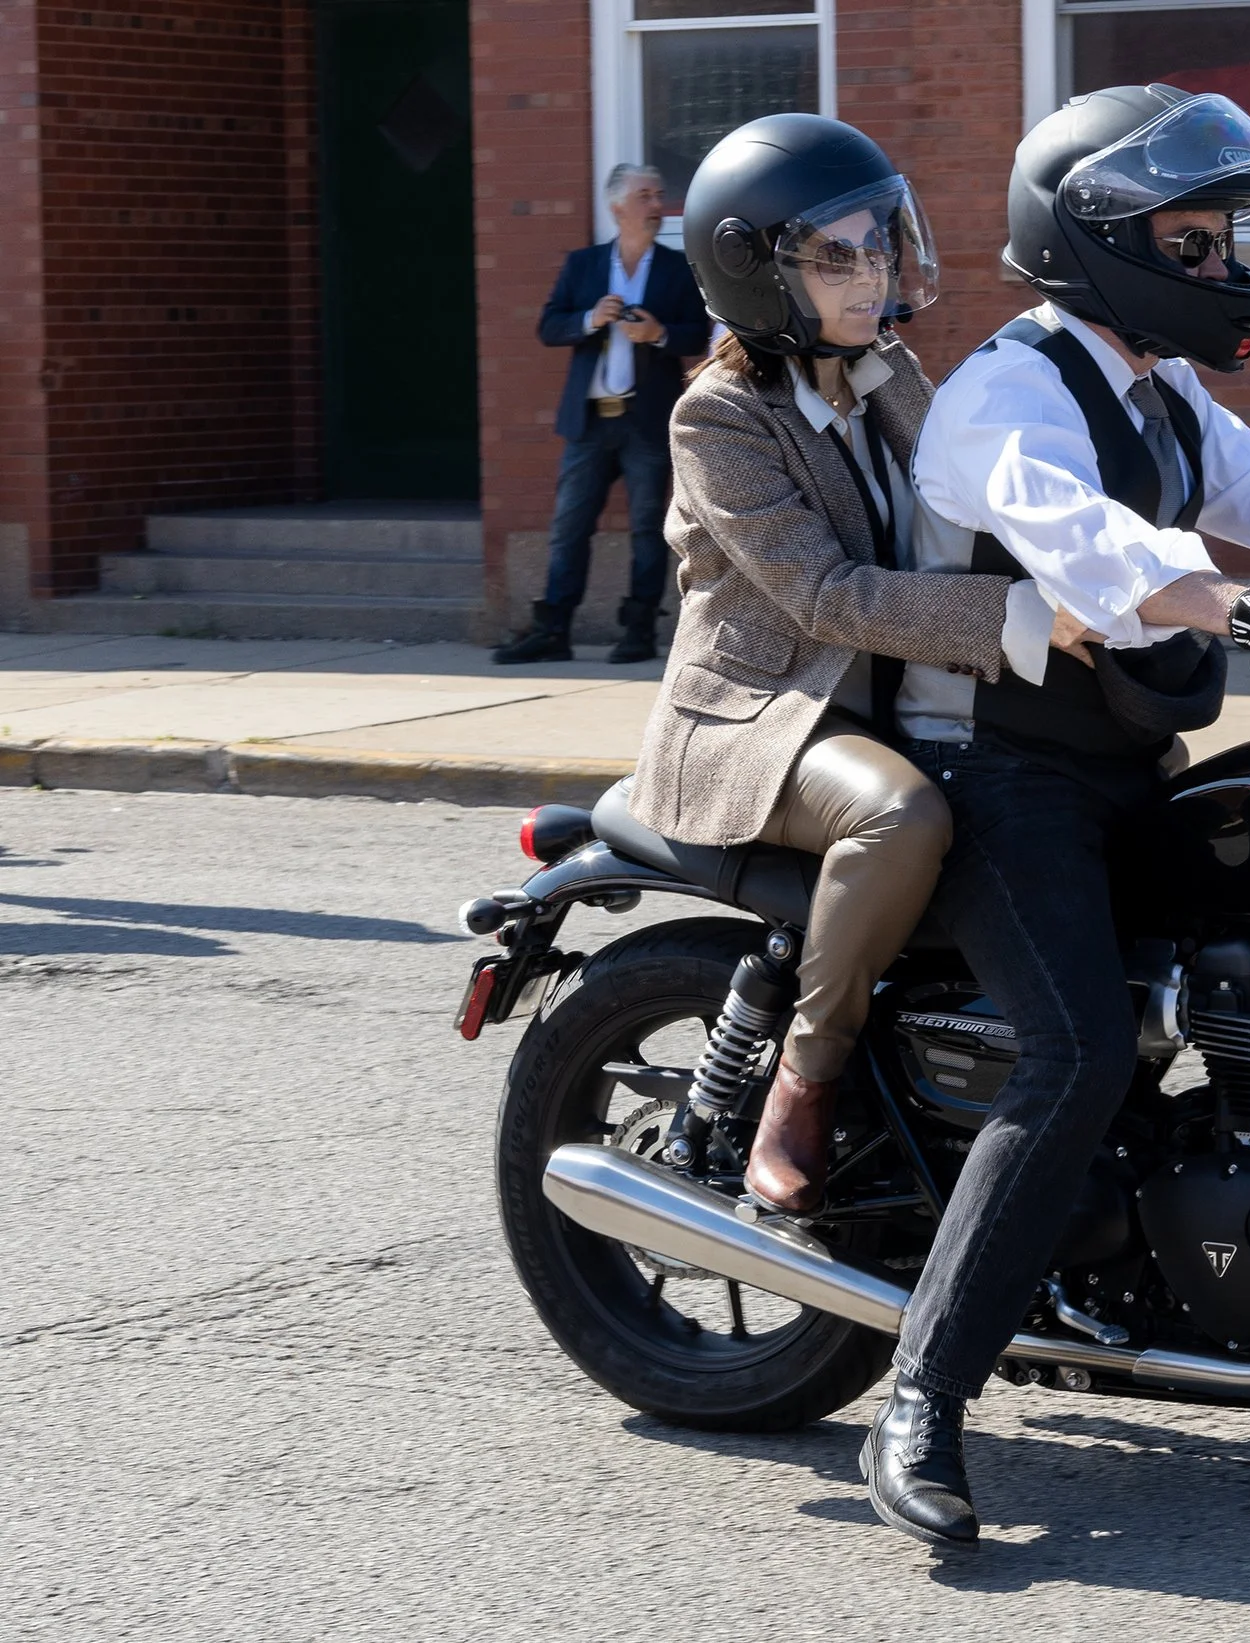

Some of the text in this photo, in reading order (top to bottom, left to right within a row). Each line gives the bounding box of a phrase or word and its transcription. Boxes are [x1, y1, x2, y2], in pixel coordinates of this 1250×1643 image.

[898, 1014, 944, 1028] SPEED
[947, 1020, 984, 1034] TWIN
[511, 1073, 538, 1154] 150/70
[534, 1052, 547, 1073] R
[544, 1027, 561, 1053] 17
